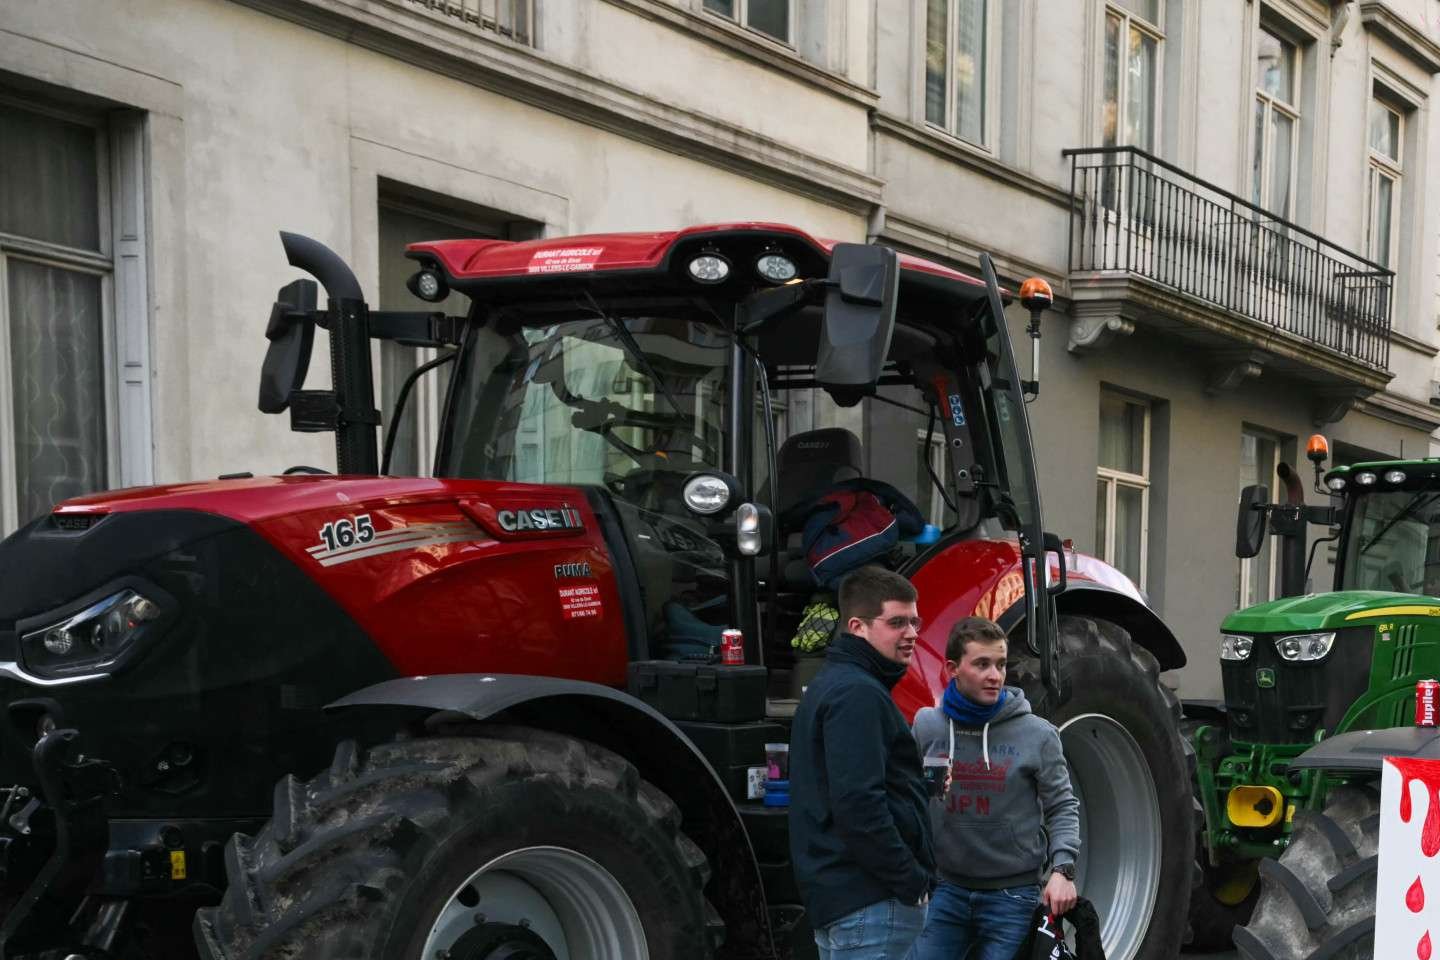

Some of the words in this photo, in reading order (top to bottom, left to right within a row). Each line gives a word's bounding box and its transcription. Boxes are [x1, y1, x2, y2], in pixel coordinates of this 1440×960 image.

[319, 513, 376, 552] 165
[498, 509, 562, 531] CASE
[554, 562, 591, 579] PUMA
[1421, 682, 1436, 726] Jupiler
